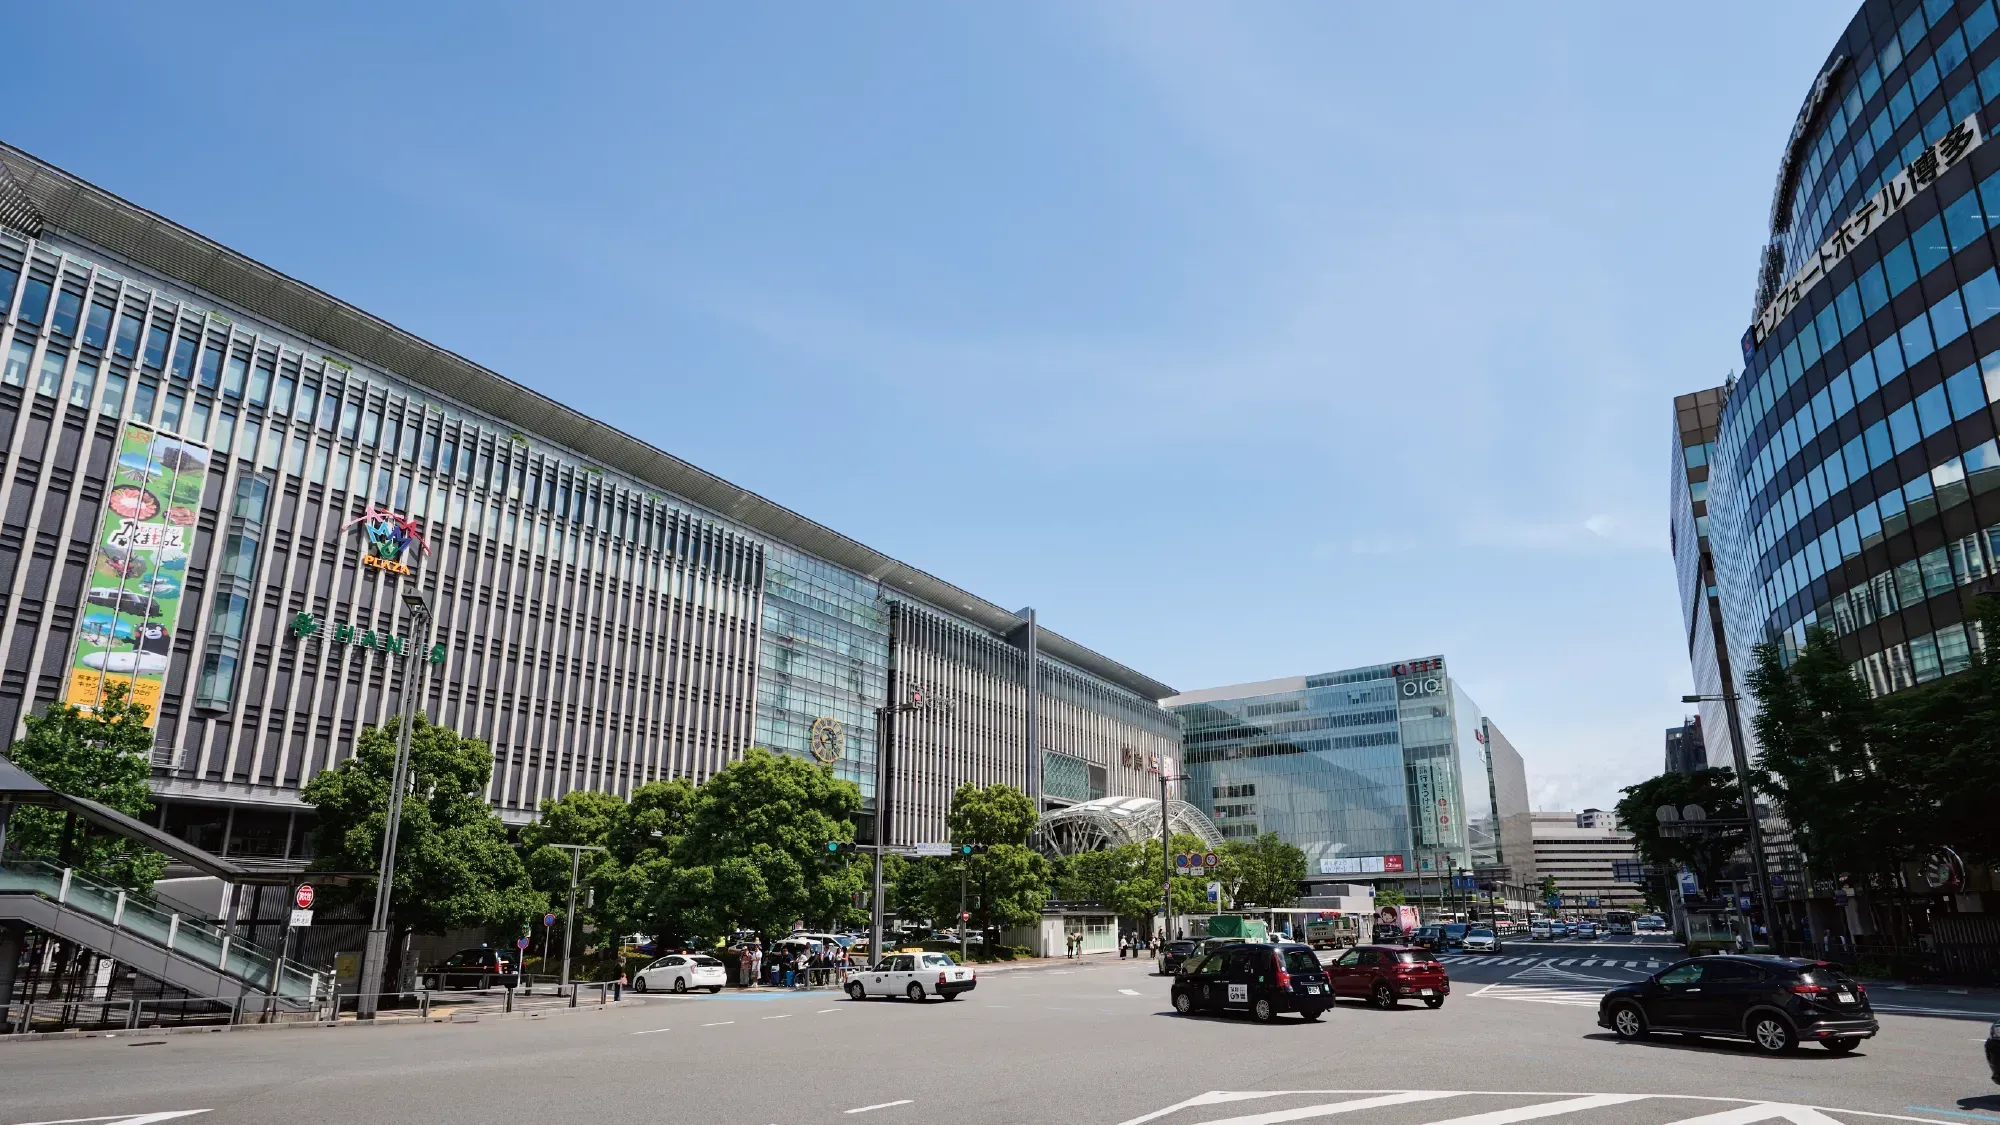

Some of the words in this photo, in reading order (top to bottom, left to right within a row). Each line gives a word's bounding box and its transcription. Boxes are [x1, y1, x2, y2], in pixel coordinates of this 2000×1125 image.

[1754, 121, 1975, 345] コンフォートホテル博多
[363, 553, 411, 576] PLAZA
[335, 623, 446, 664] HANS
[1391, 657, 1443, 677] KITTE
